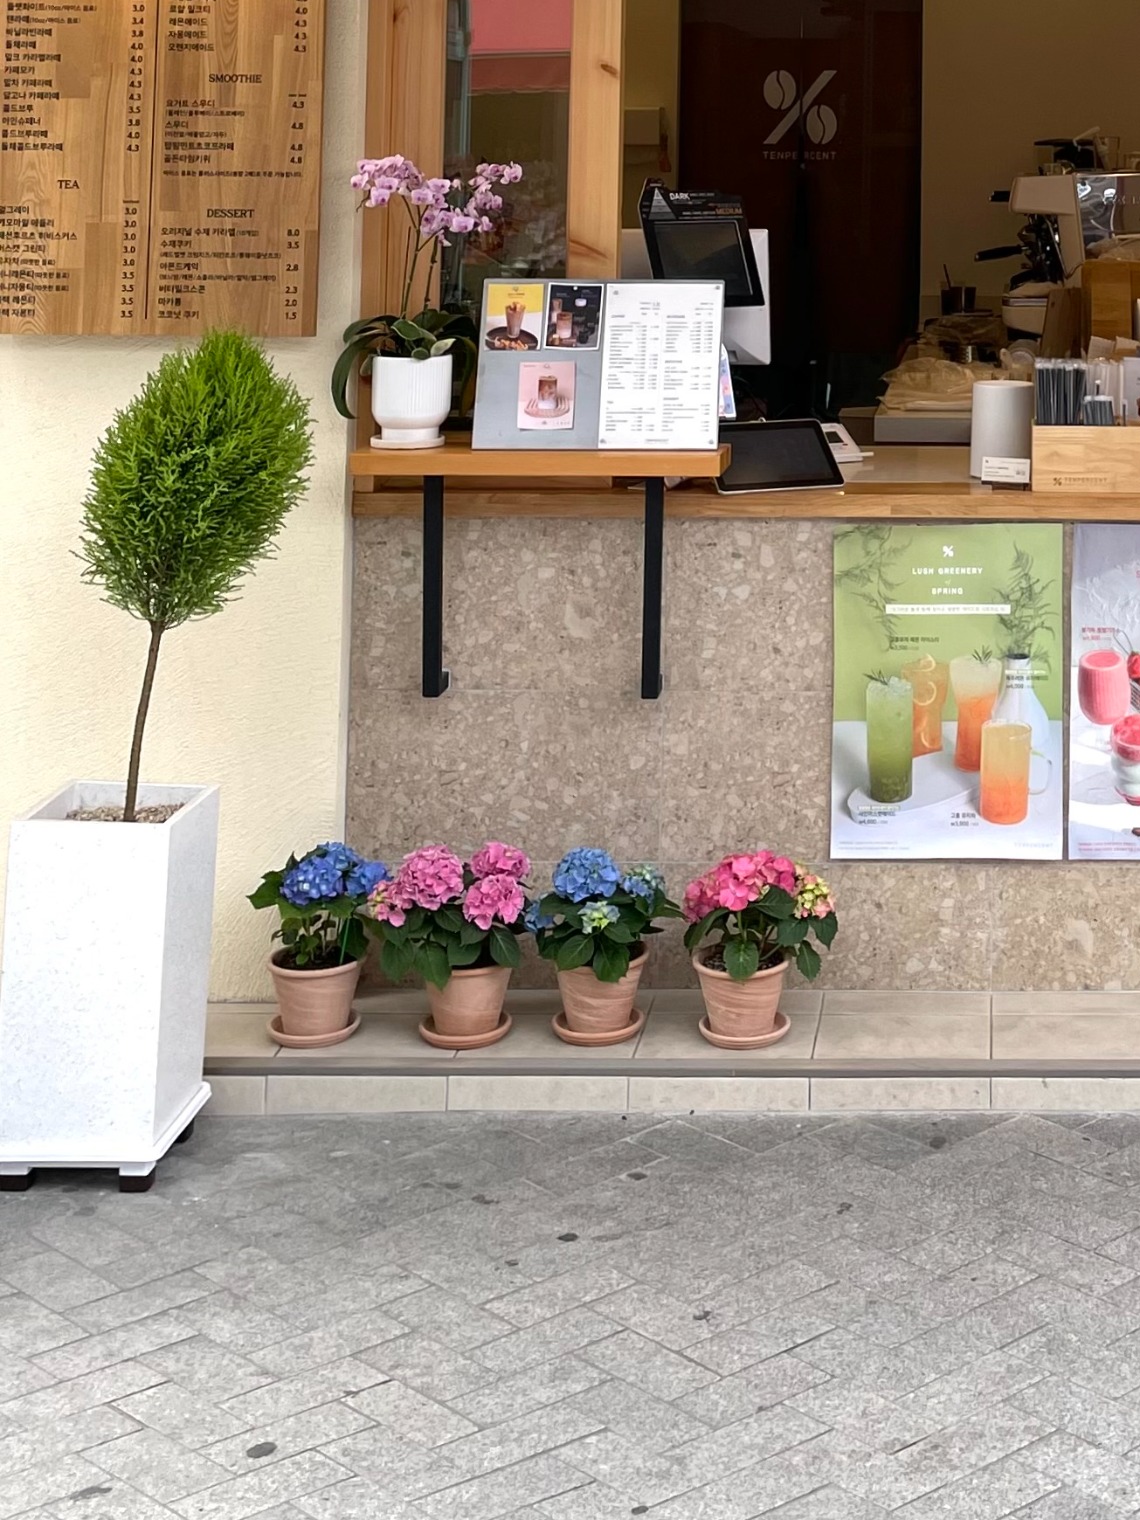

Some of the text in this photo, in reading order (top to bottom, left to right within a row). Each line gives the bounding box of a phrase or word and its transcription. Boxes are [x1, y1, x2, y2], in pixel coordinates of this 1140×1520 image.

[295, 7, 308, 15] 4.0
[132, 17, 144, 25] 3.4
[132, 30, 144, 38] 3.8
[208, 74, 263, 84] SMOOTHIE
[129, 93, 141, 101] 4.3
[191, 99, 215, 108] 스무디
[292, 101, 304, 109] 4.3
[165, 121, 189, 129] 스무디
[127, 144, 139, 152] 4.3
[763, 151, 837, 160] TENPERCENT
[58, 180, 80, 189] TEA
[669, 192, 690, 200] DARK
[125, 207, 137, 215] 3.0
[207, 209, 255, 218] DESSERT
[124, 233, 136, 241] 3.0
[287, 229, 300, 237] 8.0
[287, 241, 300, 249] 3.5
[286, 264, 299, 272] 2.8
[122, 272, 135, 280] 3.5
[285, 286, 298, 294] 2.3
[121, 297, 134, 305] 3.5
[285, 299, 298, 307] 2.0
[120, 310, 133, 318] 3.5
[285, 312, 297, 320] 1.5
[912, 567, 983, 575] LUSH GREENERY
[931, 587, 963, 595] SPRING
